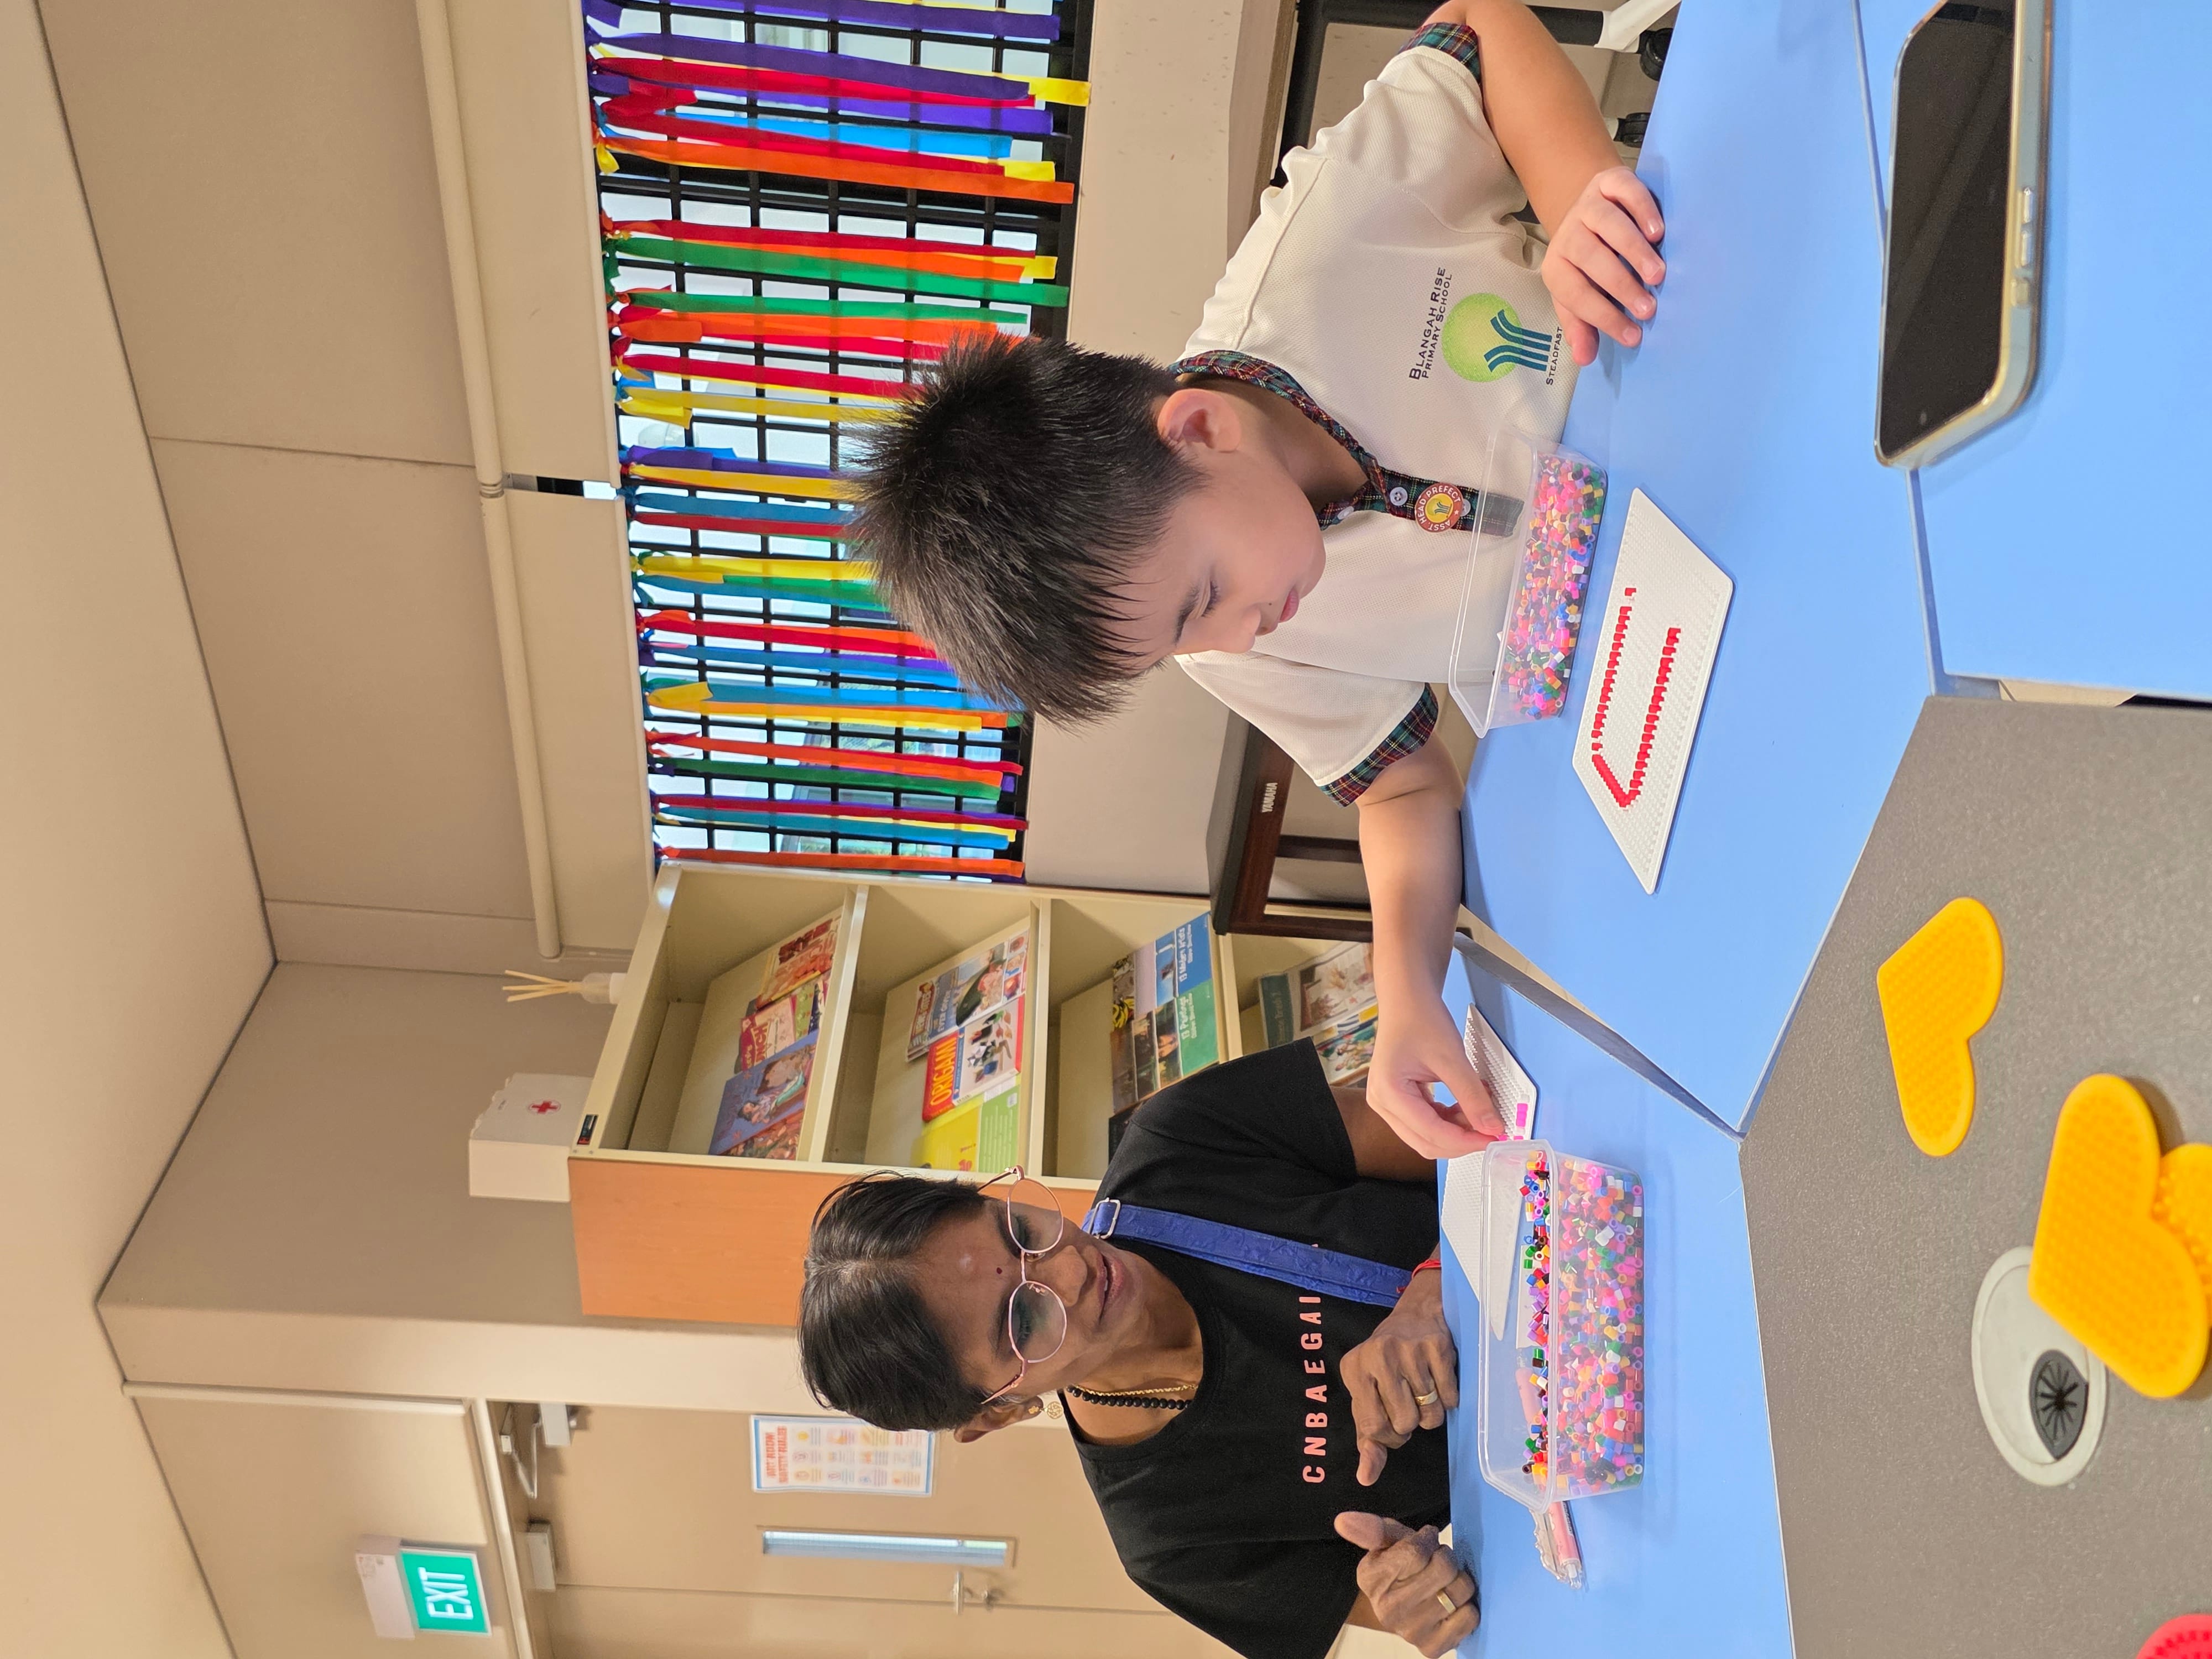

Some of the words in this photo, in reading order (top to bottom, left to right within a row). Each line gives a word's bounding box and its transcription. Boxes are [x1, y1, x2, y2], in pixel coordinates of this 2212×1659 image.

[1430, 267, 1446, 302] RISE
[1421, 326, 1441, 379] PRIMARY
[1436, 274, 1452, 322] SCHOOL
[1546, 326, 1563, 385] STEADFAST
[1417, 498, 1427, 524] HEAD
[1426, 485, 1461, 503] PREFECT
[1428, 519, 1451, 531] ASST.
[1261, 782, 1278, 812] YAMAHA
[930, 1036, 957, 1105] ORIGAMI
[418, 1567, 474, 1620] EXIT
